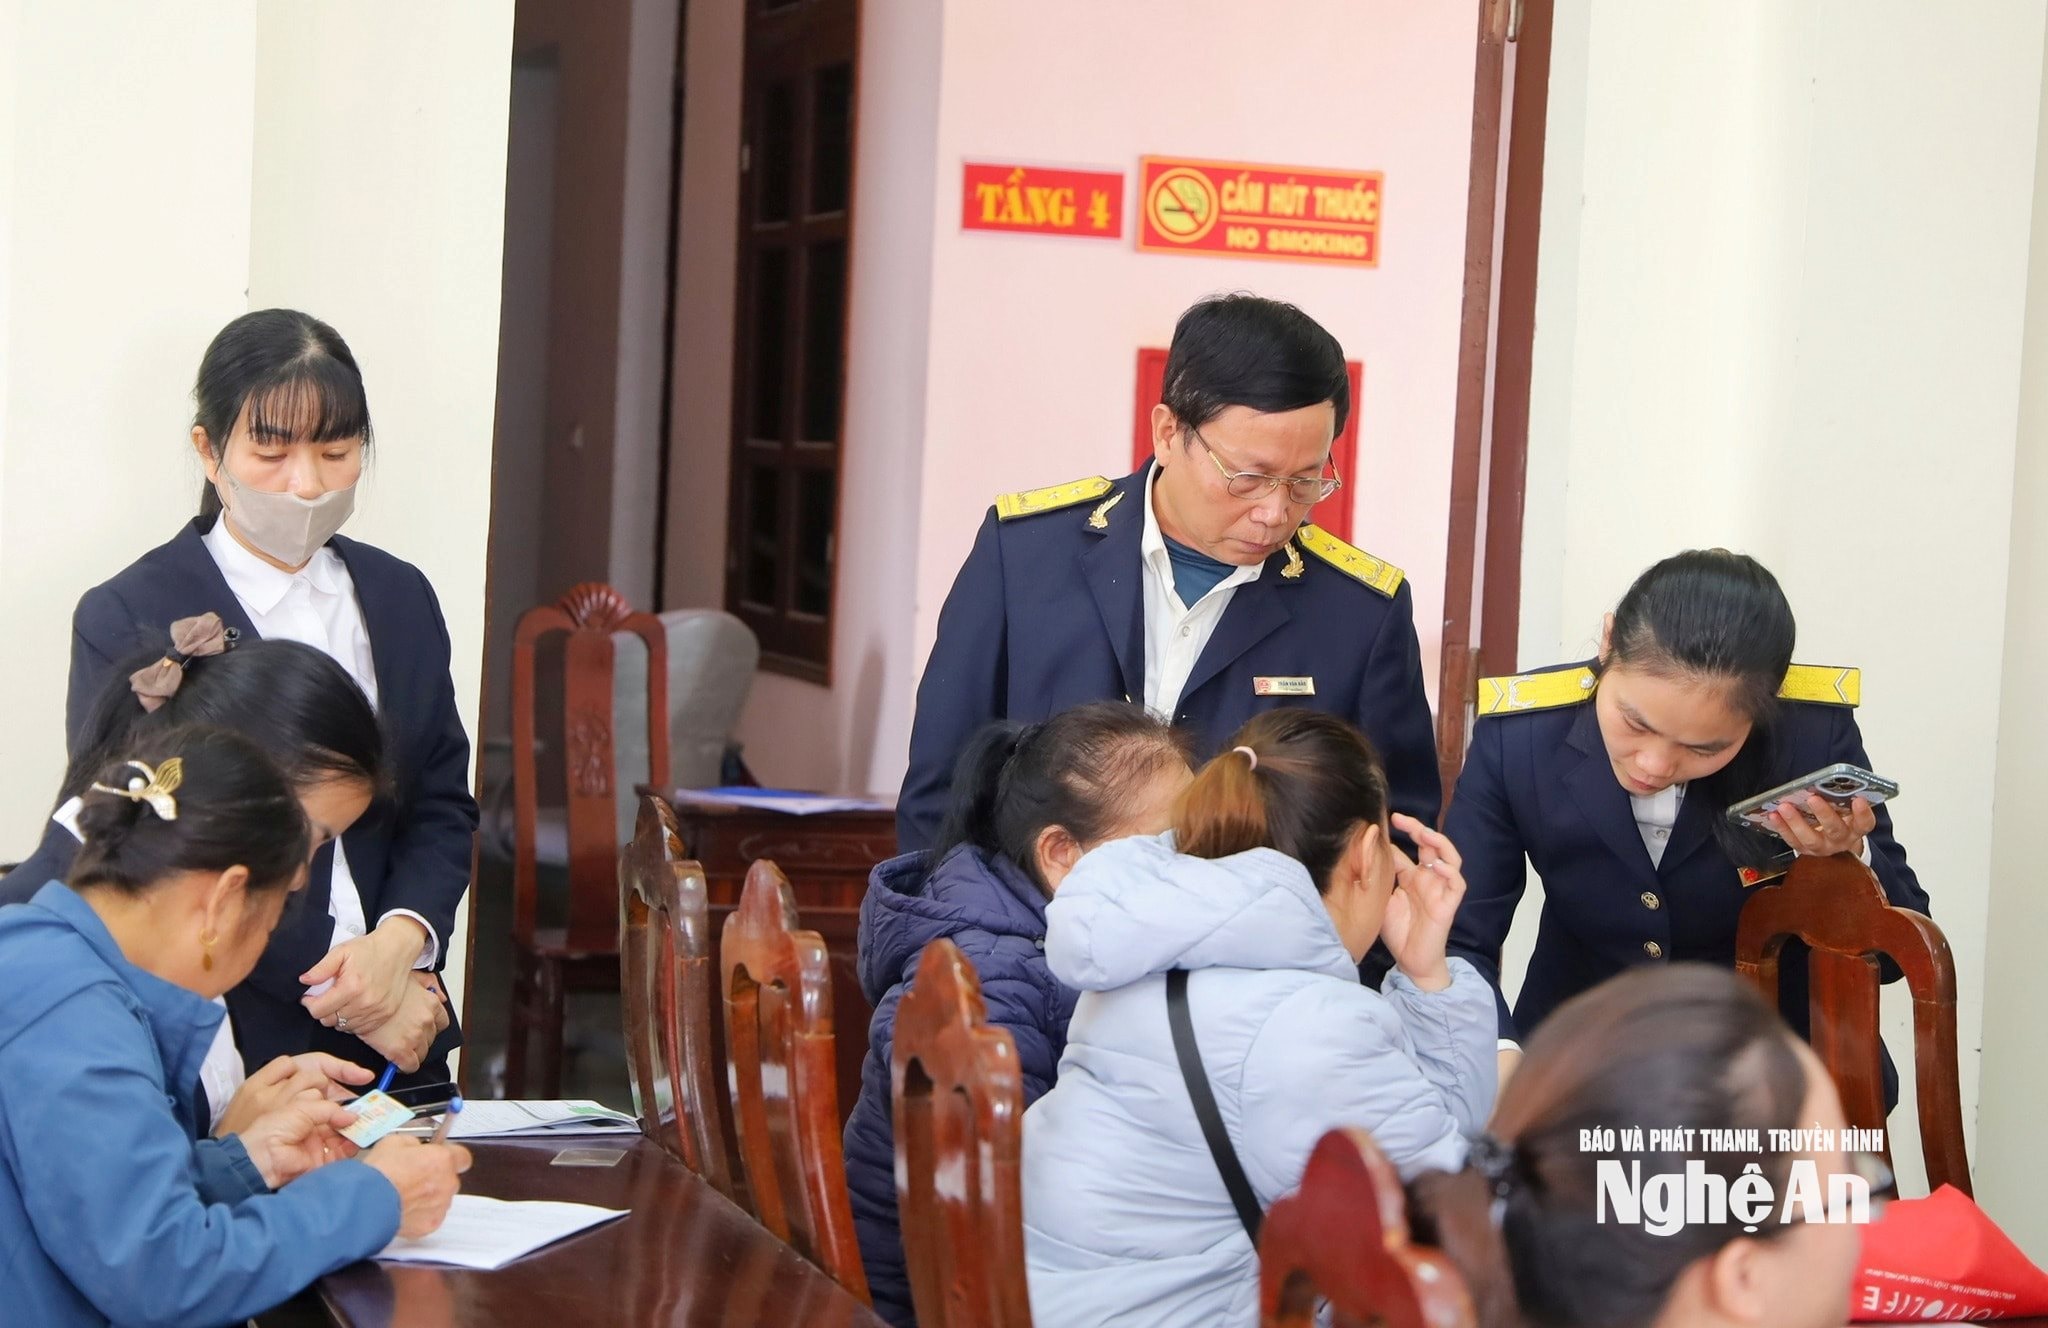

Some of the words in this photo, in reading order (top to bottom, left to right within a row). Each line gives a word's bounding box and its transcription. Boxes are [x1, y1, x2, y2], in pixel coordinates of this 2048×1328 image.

[1086, 189, 1111, 229] 4
[1268, 176, 1309, 216] HÚT
[1312, 179, 1376, 221] THUỐC
[1226, 226, 1260, 250] NO
[1266, 228, 1367, 257] SMOKING
